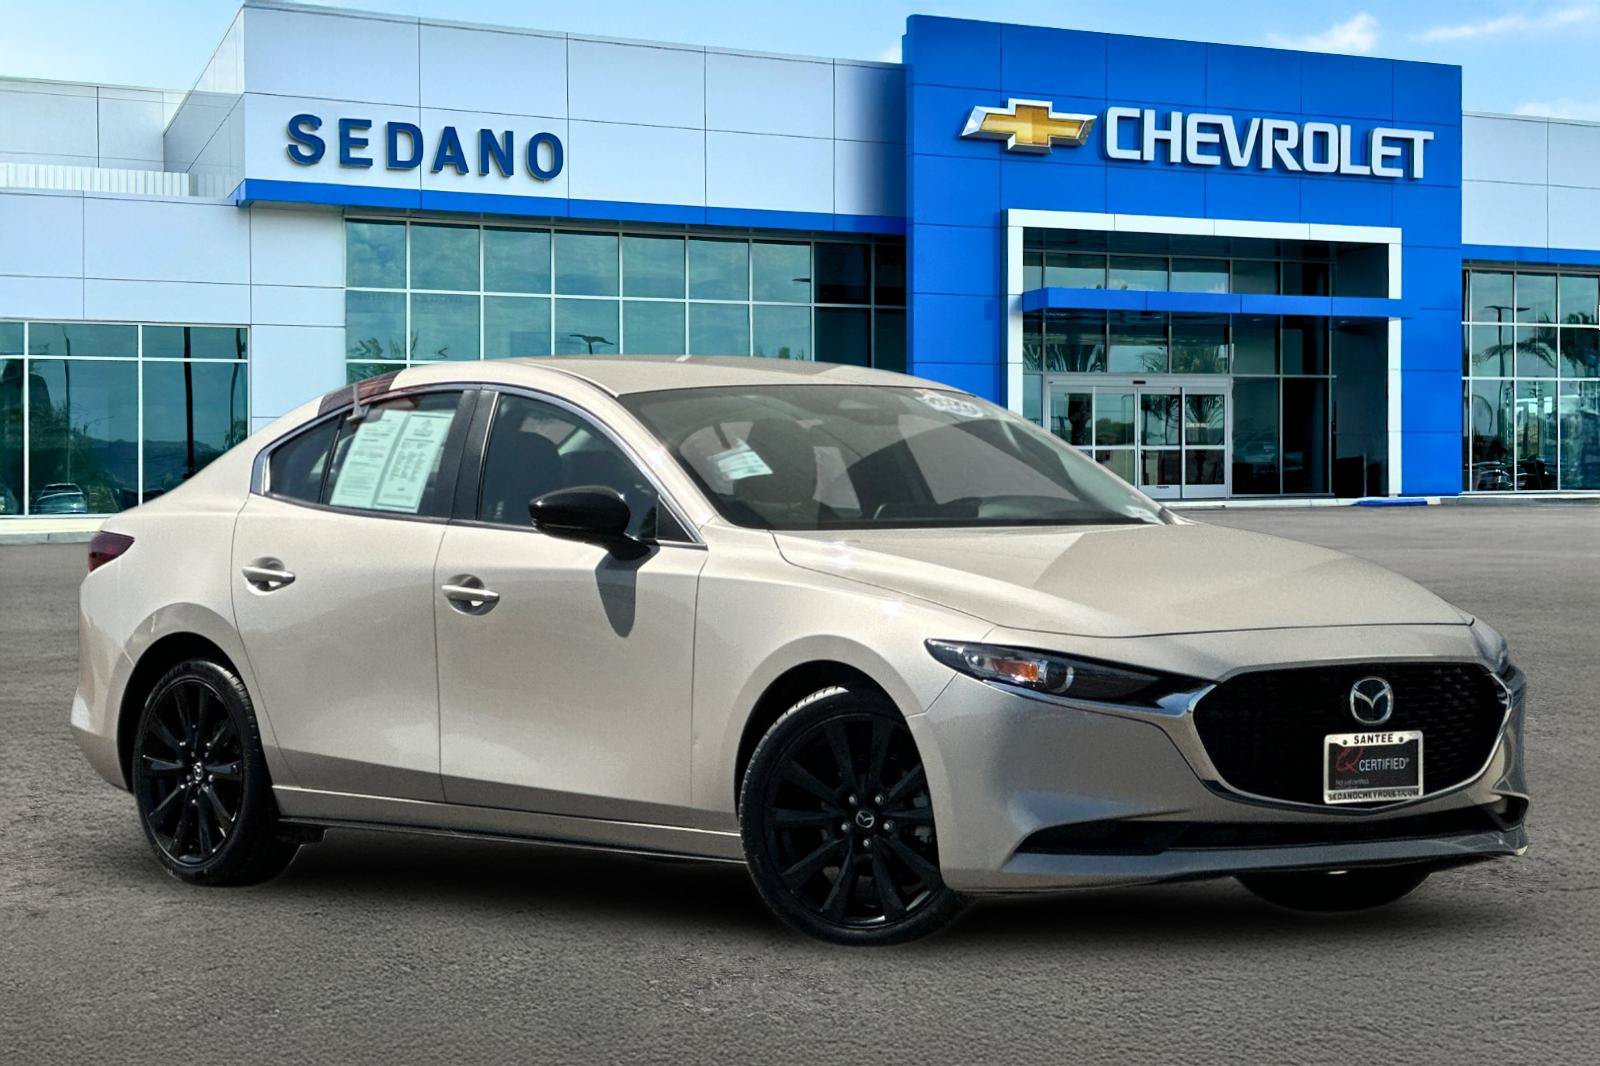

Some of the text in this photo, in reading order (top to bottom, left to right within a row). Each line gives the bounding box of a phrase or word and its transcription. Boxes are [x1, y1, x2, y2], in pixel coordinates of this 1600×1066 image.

[286, 113, 564, 182] SEDANO
[1105, 106, 1435, 180] CHEVROLET
[1353, 733, 1394, 745] SANTEE
